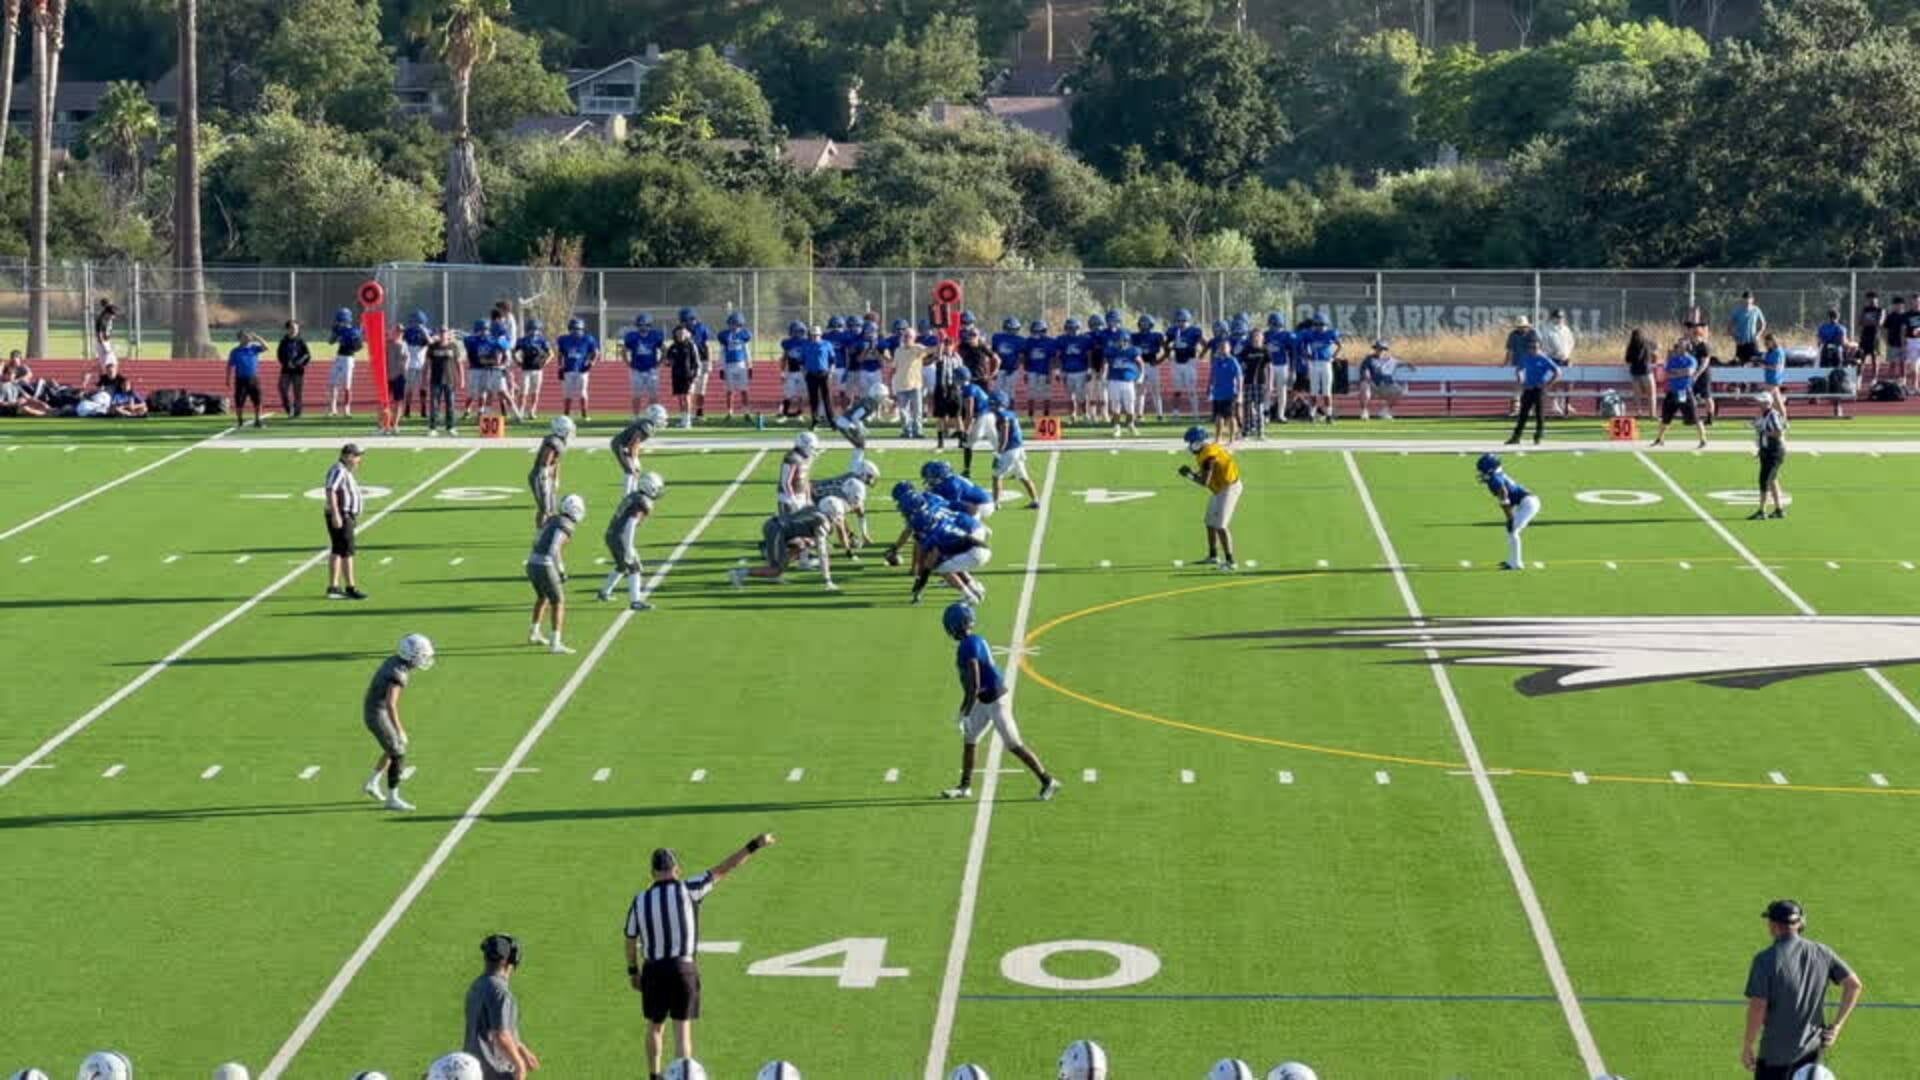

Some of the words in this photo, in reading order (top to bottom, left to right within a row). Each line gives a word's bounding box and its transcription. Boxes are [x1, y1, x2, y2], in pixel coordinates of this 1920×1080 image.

[1366, 304, 1445, 337] PARK
[481, 417, 499, 434] 30
[1038, 419, 1056, 436] 40
[1614, 419, 1632, 436] 50
